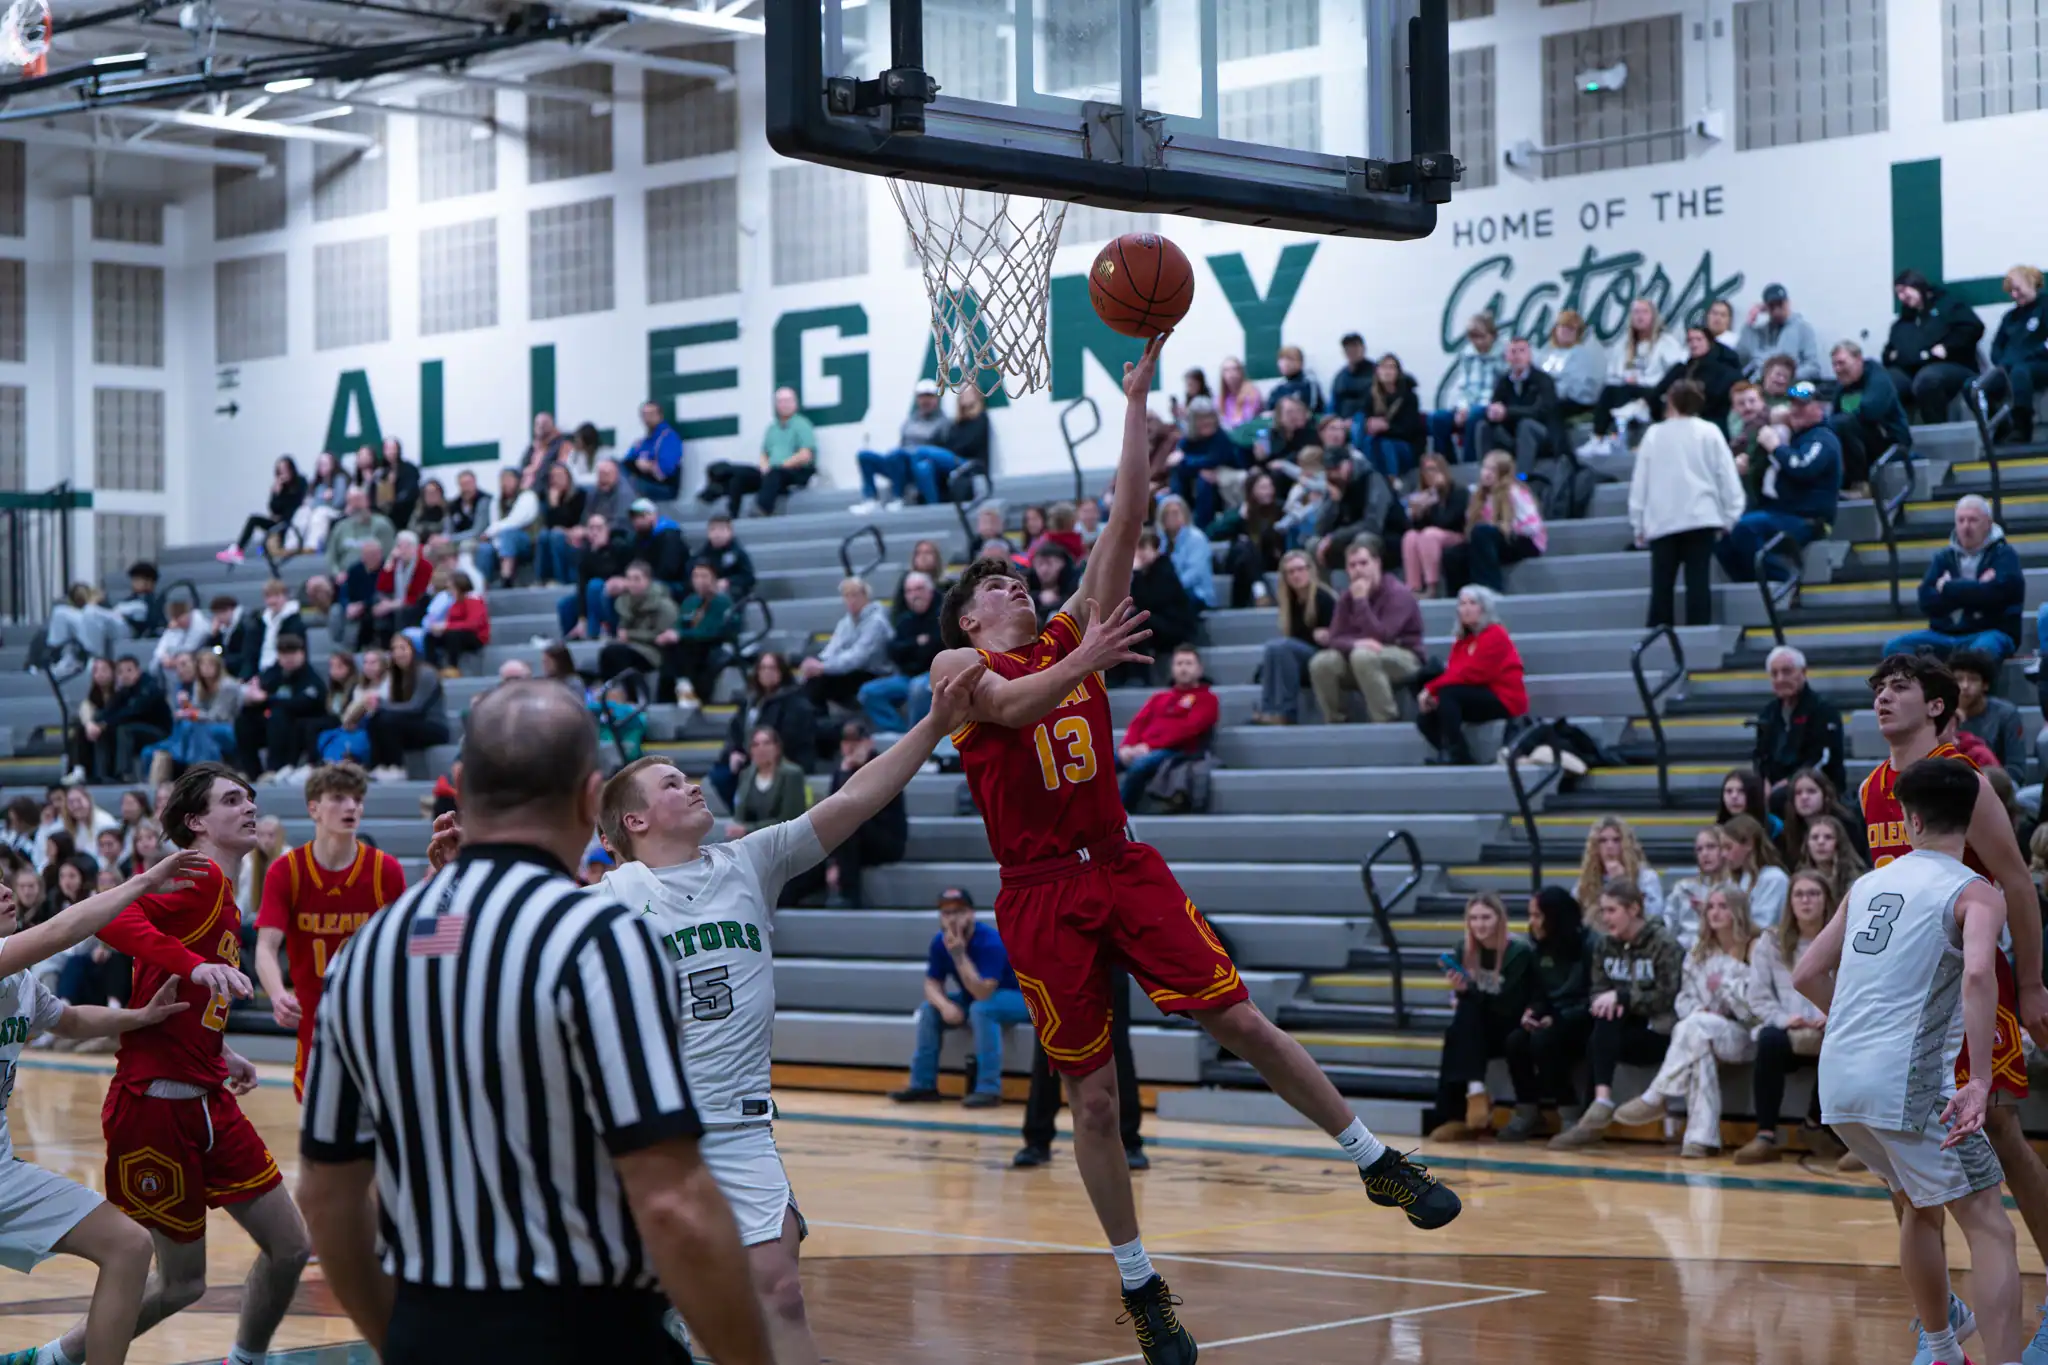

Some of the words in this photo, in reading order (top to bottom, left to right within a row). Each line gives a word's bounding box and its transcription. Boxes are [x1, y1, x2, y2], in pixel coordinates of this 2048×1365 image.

[1452, 208, 1554, 248] HOME
[1579, 198, 1627, 232] OF
[1650, 185, 1725, 223] THE
[323, 240, 1320, 468] ALLEGANY
[1434, 244, 1746, 404] Gators
[1033, 715, 1097, 791] 13
[1867, 821, 1912, 849] OLEA
[1852, 892, 1905, 956] 3
[688, 964, 734, 1022] 5
